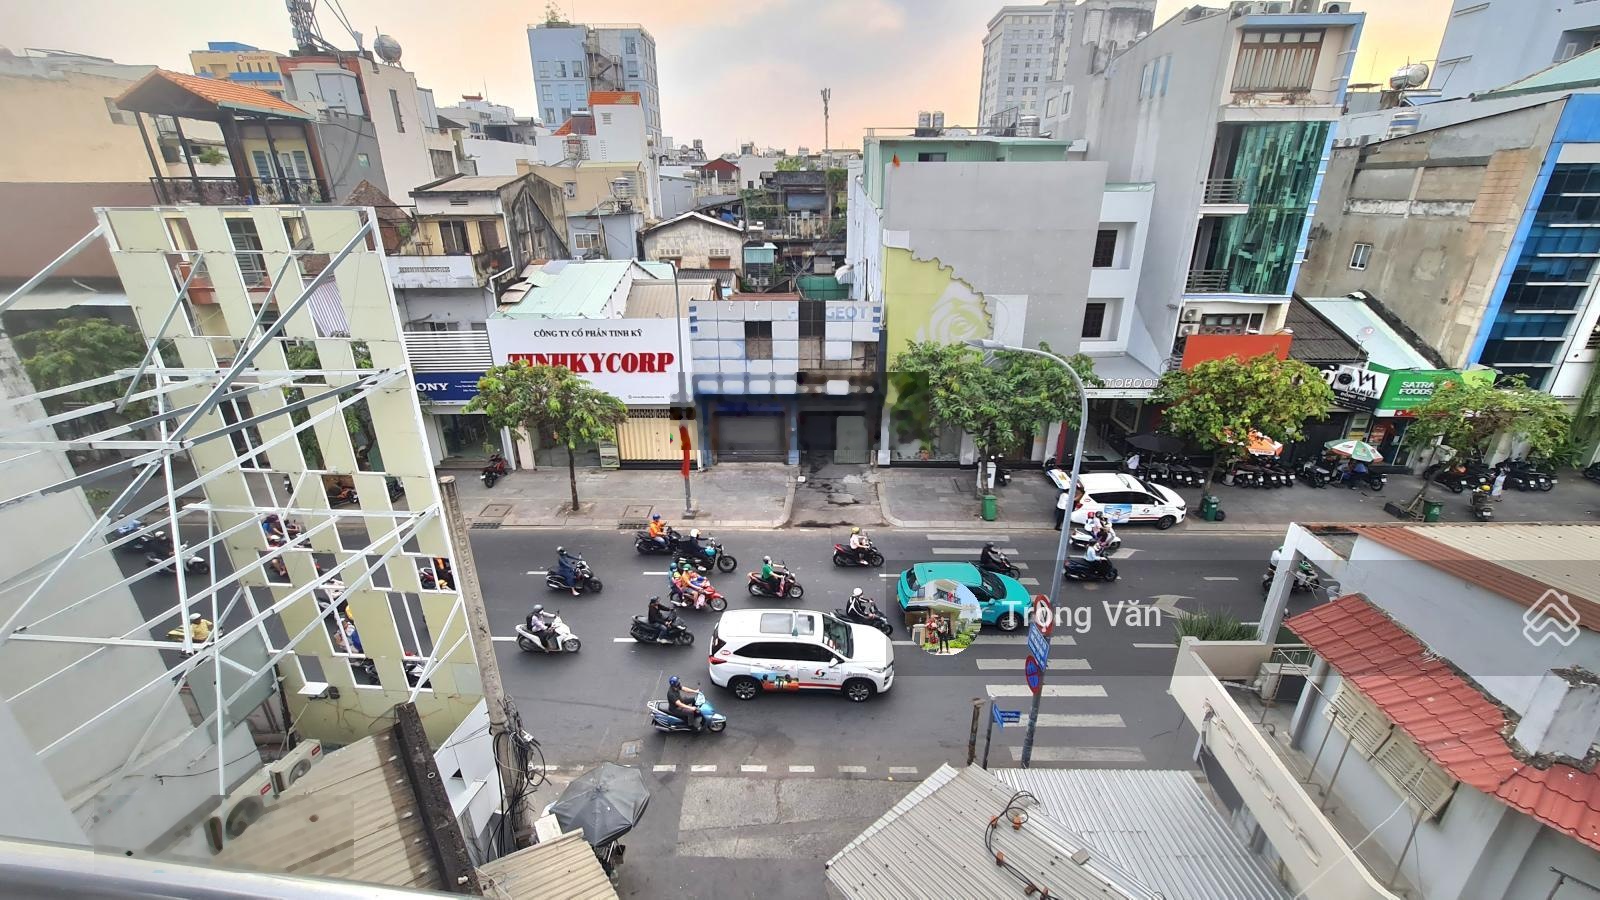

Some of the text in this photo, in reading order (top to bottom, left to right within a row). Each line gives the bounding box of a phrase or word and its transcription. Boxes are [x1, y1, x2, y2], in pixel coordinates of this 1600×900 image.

[533, 329, 558, 337] CÔNG
[415, 382, 449, 392] ONY
[1401, 381, 1435, 389] SATRA
[1398, 388, 1433, 396] FOODS
